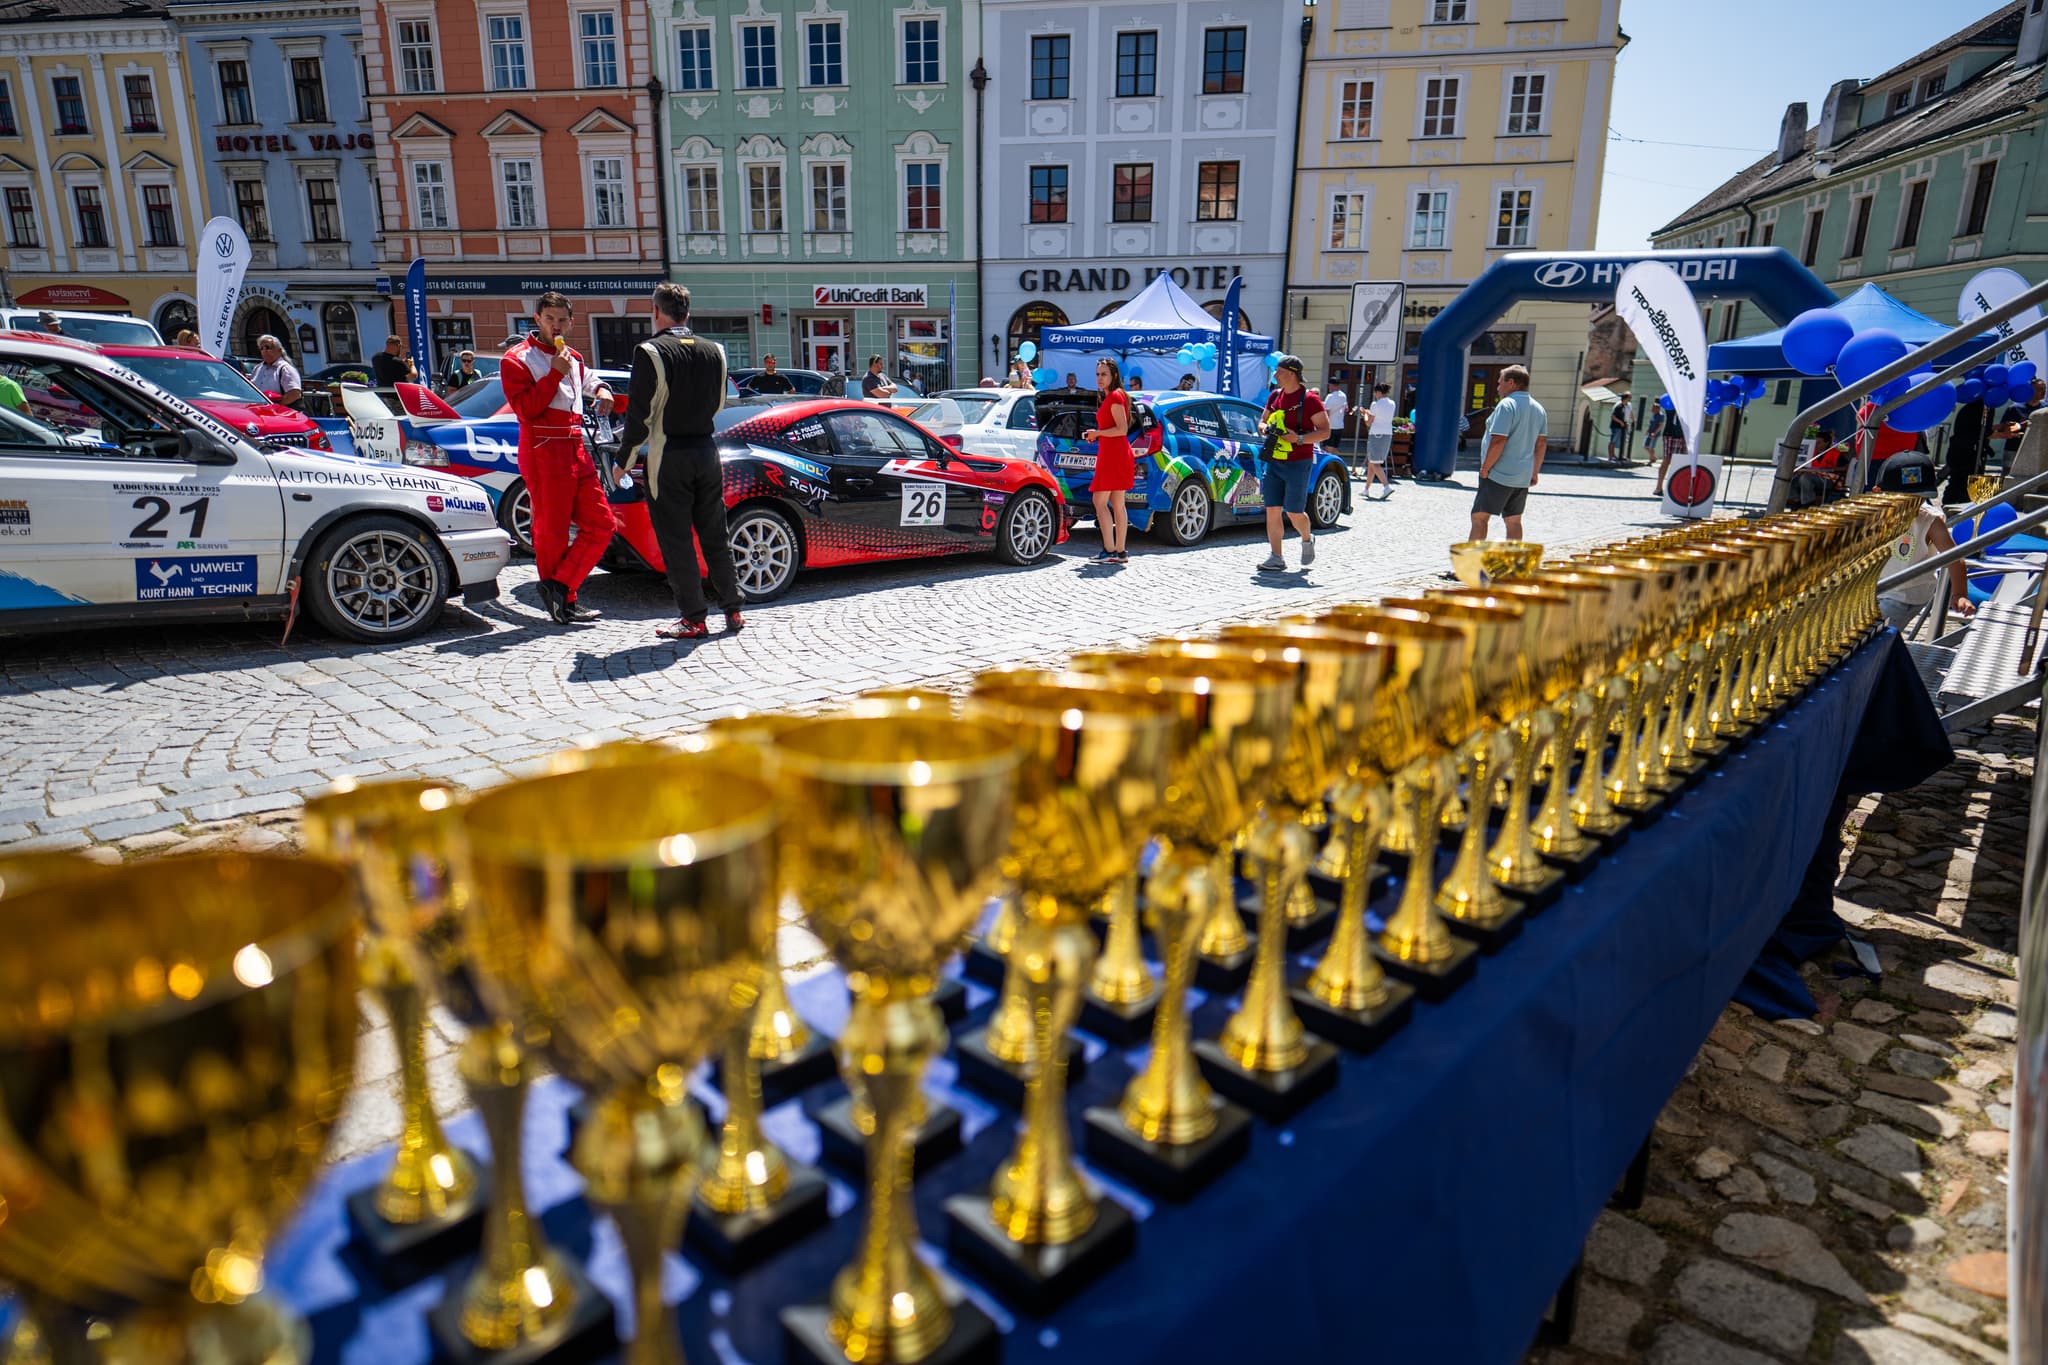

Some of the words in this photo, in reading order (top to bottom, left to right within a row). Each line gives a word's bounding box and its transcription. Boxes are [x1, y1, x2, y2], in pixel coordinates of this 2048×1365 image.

[216, 134, 297, 152] HOTEL
[308, 132, 375, 152] VAJG
[1018, 267, 1130, 292] GRAND
[1592, 259, 1737, 284] HYDAI
[426, 281, 440, 290] ISTA
[456, 280, 486, 290] CENTRUM
[521, 281, 544, 290] OPTIKA
[550, 281, 581, 290] ORDINACE
[588, 280, 622, 290] ESTETICKÁ
[623, 280, 657, 290] CHIRURGIE
[830, 288, 888, 303] UniCredit
[892, 287, 924, 303] Bank
[215, 330, 225, 349] AR
[220, 286, 236, 329] SERVIS
[1064, 336, 1104, 344] HYUNDAI
[1147, 332, 1190, 342] HYUNDAI
[154, 390, 240, 445] Thayaland
[355, 422, 384, 441] budbis
[790, 476, 830, 500] REVIT
[1125, 492, 1147, 500] RECHT
[445, 496, 487, 512] MÜLLNER
[908, 492, 941, 518] 26
[130, 496, 210, 538] 21
[176, 541, 196, 550] AR
[190, 562, 244, 574] UMWELT
[140, 588, 166, 598] KURT
[168, 587, 194, 598] HAHN
[200, 584, 252, 594] TECHNIK
